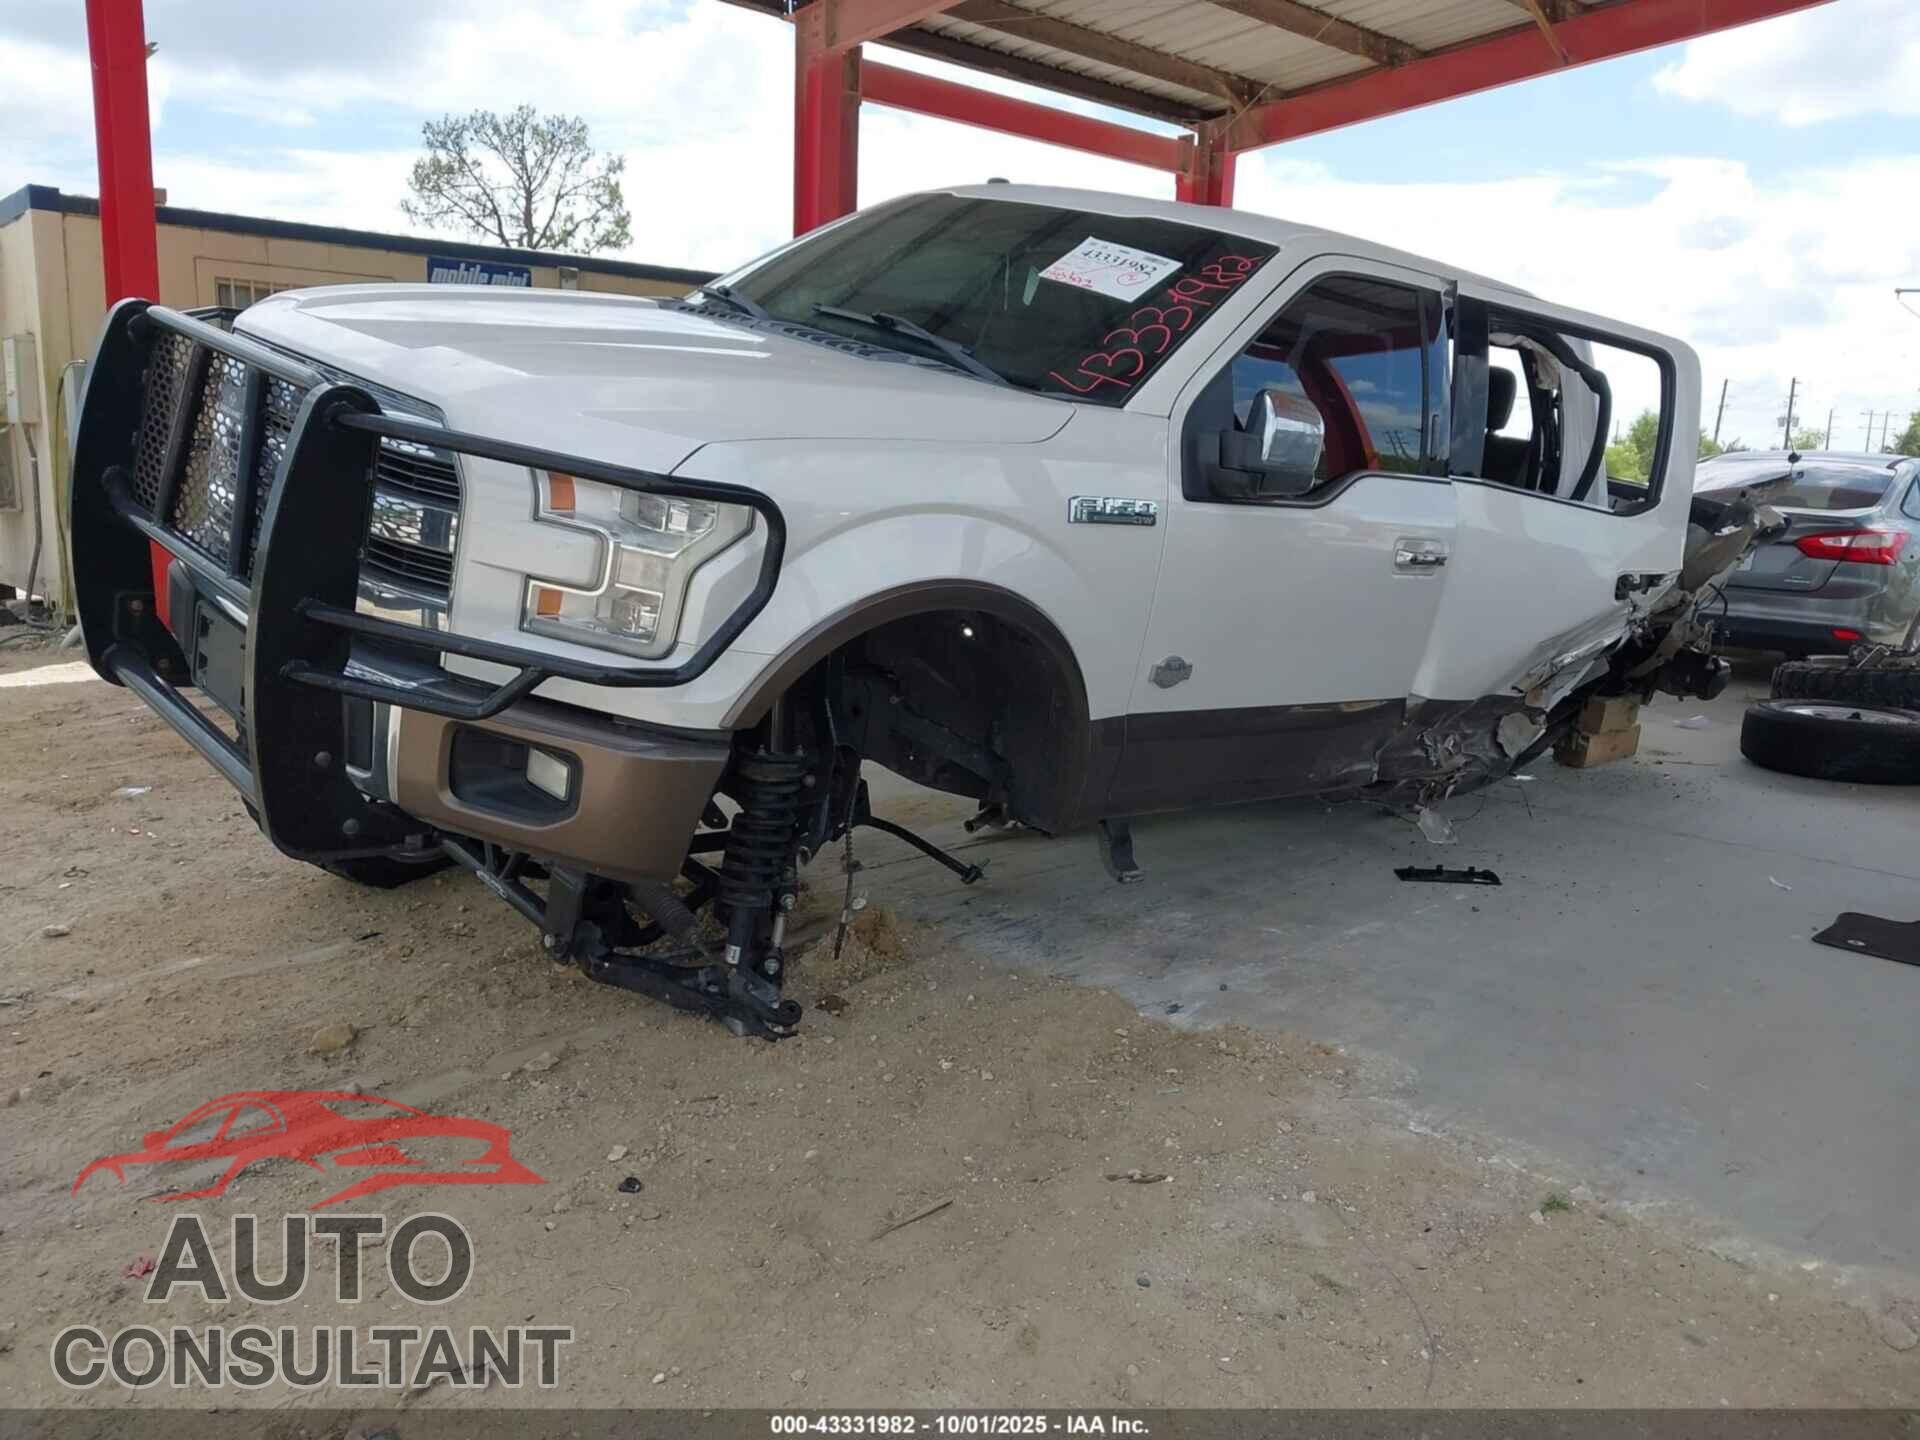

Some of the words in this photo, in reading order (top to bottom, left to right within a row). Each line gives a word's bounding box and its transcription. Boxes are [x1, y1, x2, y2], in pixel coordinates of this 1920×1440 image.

[431, 262, 488, 284] mobile
[491, 271, 529, 286] mini
[1082, 248, 1158, 276] 43331982
[1049, 255, 1264, 392] 43331982
